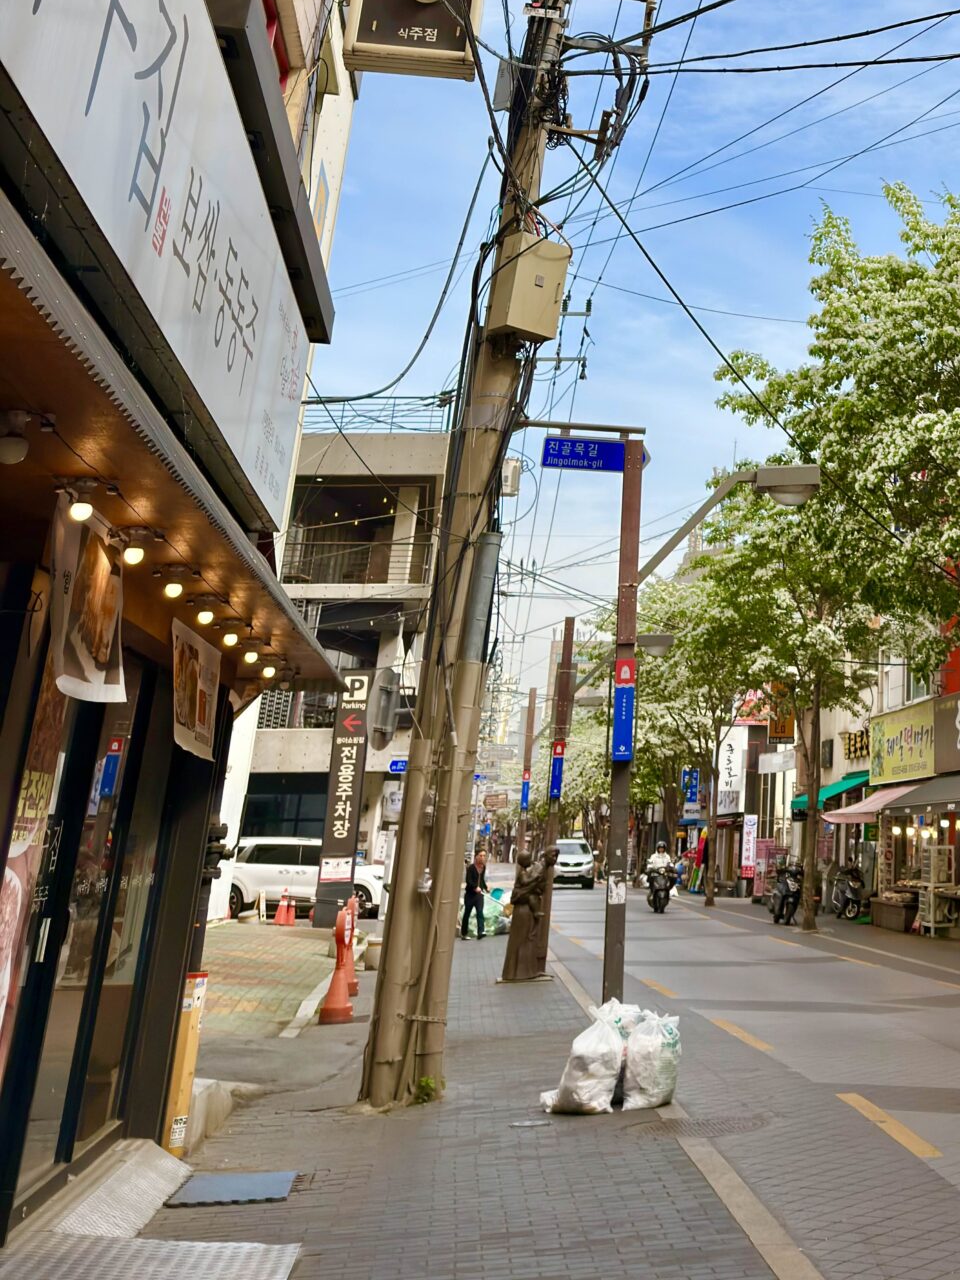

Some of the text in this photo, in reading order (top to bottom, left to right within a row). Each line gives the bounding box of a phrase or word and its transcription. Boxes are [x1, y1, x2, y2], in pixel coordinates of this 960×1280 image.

[548, 440, 598, 457] 진골목길
[341, 701, 367, 710] Parking
[332, 745, 357, 839] 전용주차장
